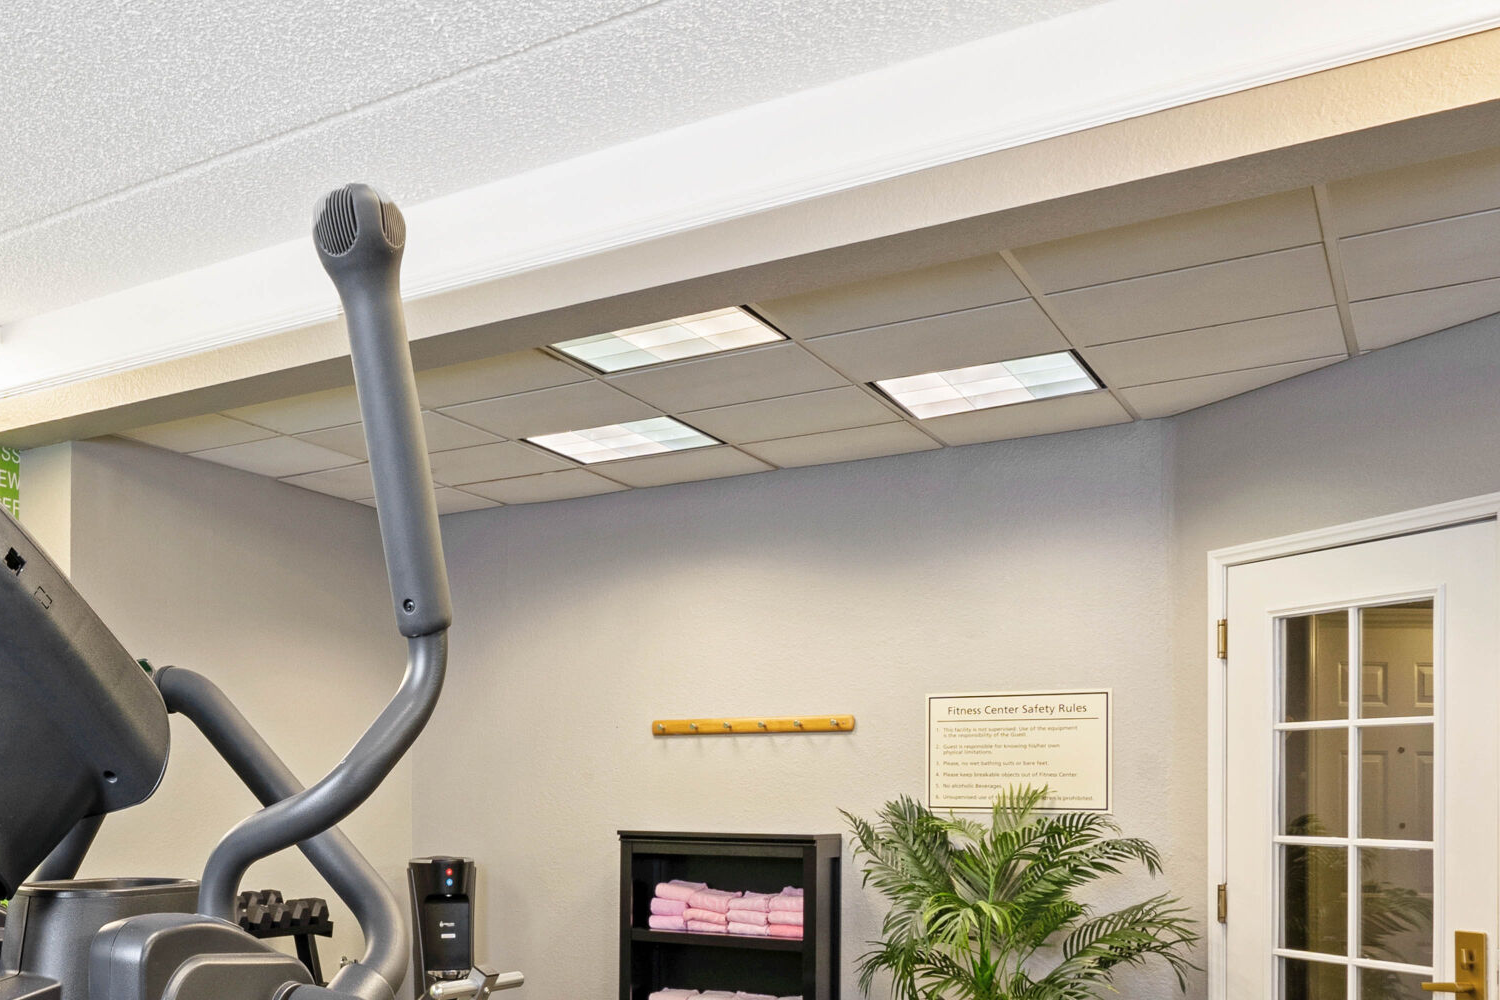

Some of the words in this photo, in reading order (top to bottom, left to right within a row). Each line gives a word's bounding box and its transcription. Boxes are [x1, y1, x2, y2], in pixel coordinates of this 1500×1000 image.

[948, 705, 981, 716] Fitness
[984, 704, 1019, 715] Center
[1021, 703, 1055, 716] Safety
[1058, 702, 1088, 713] Rules
